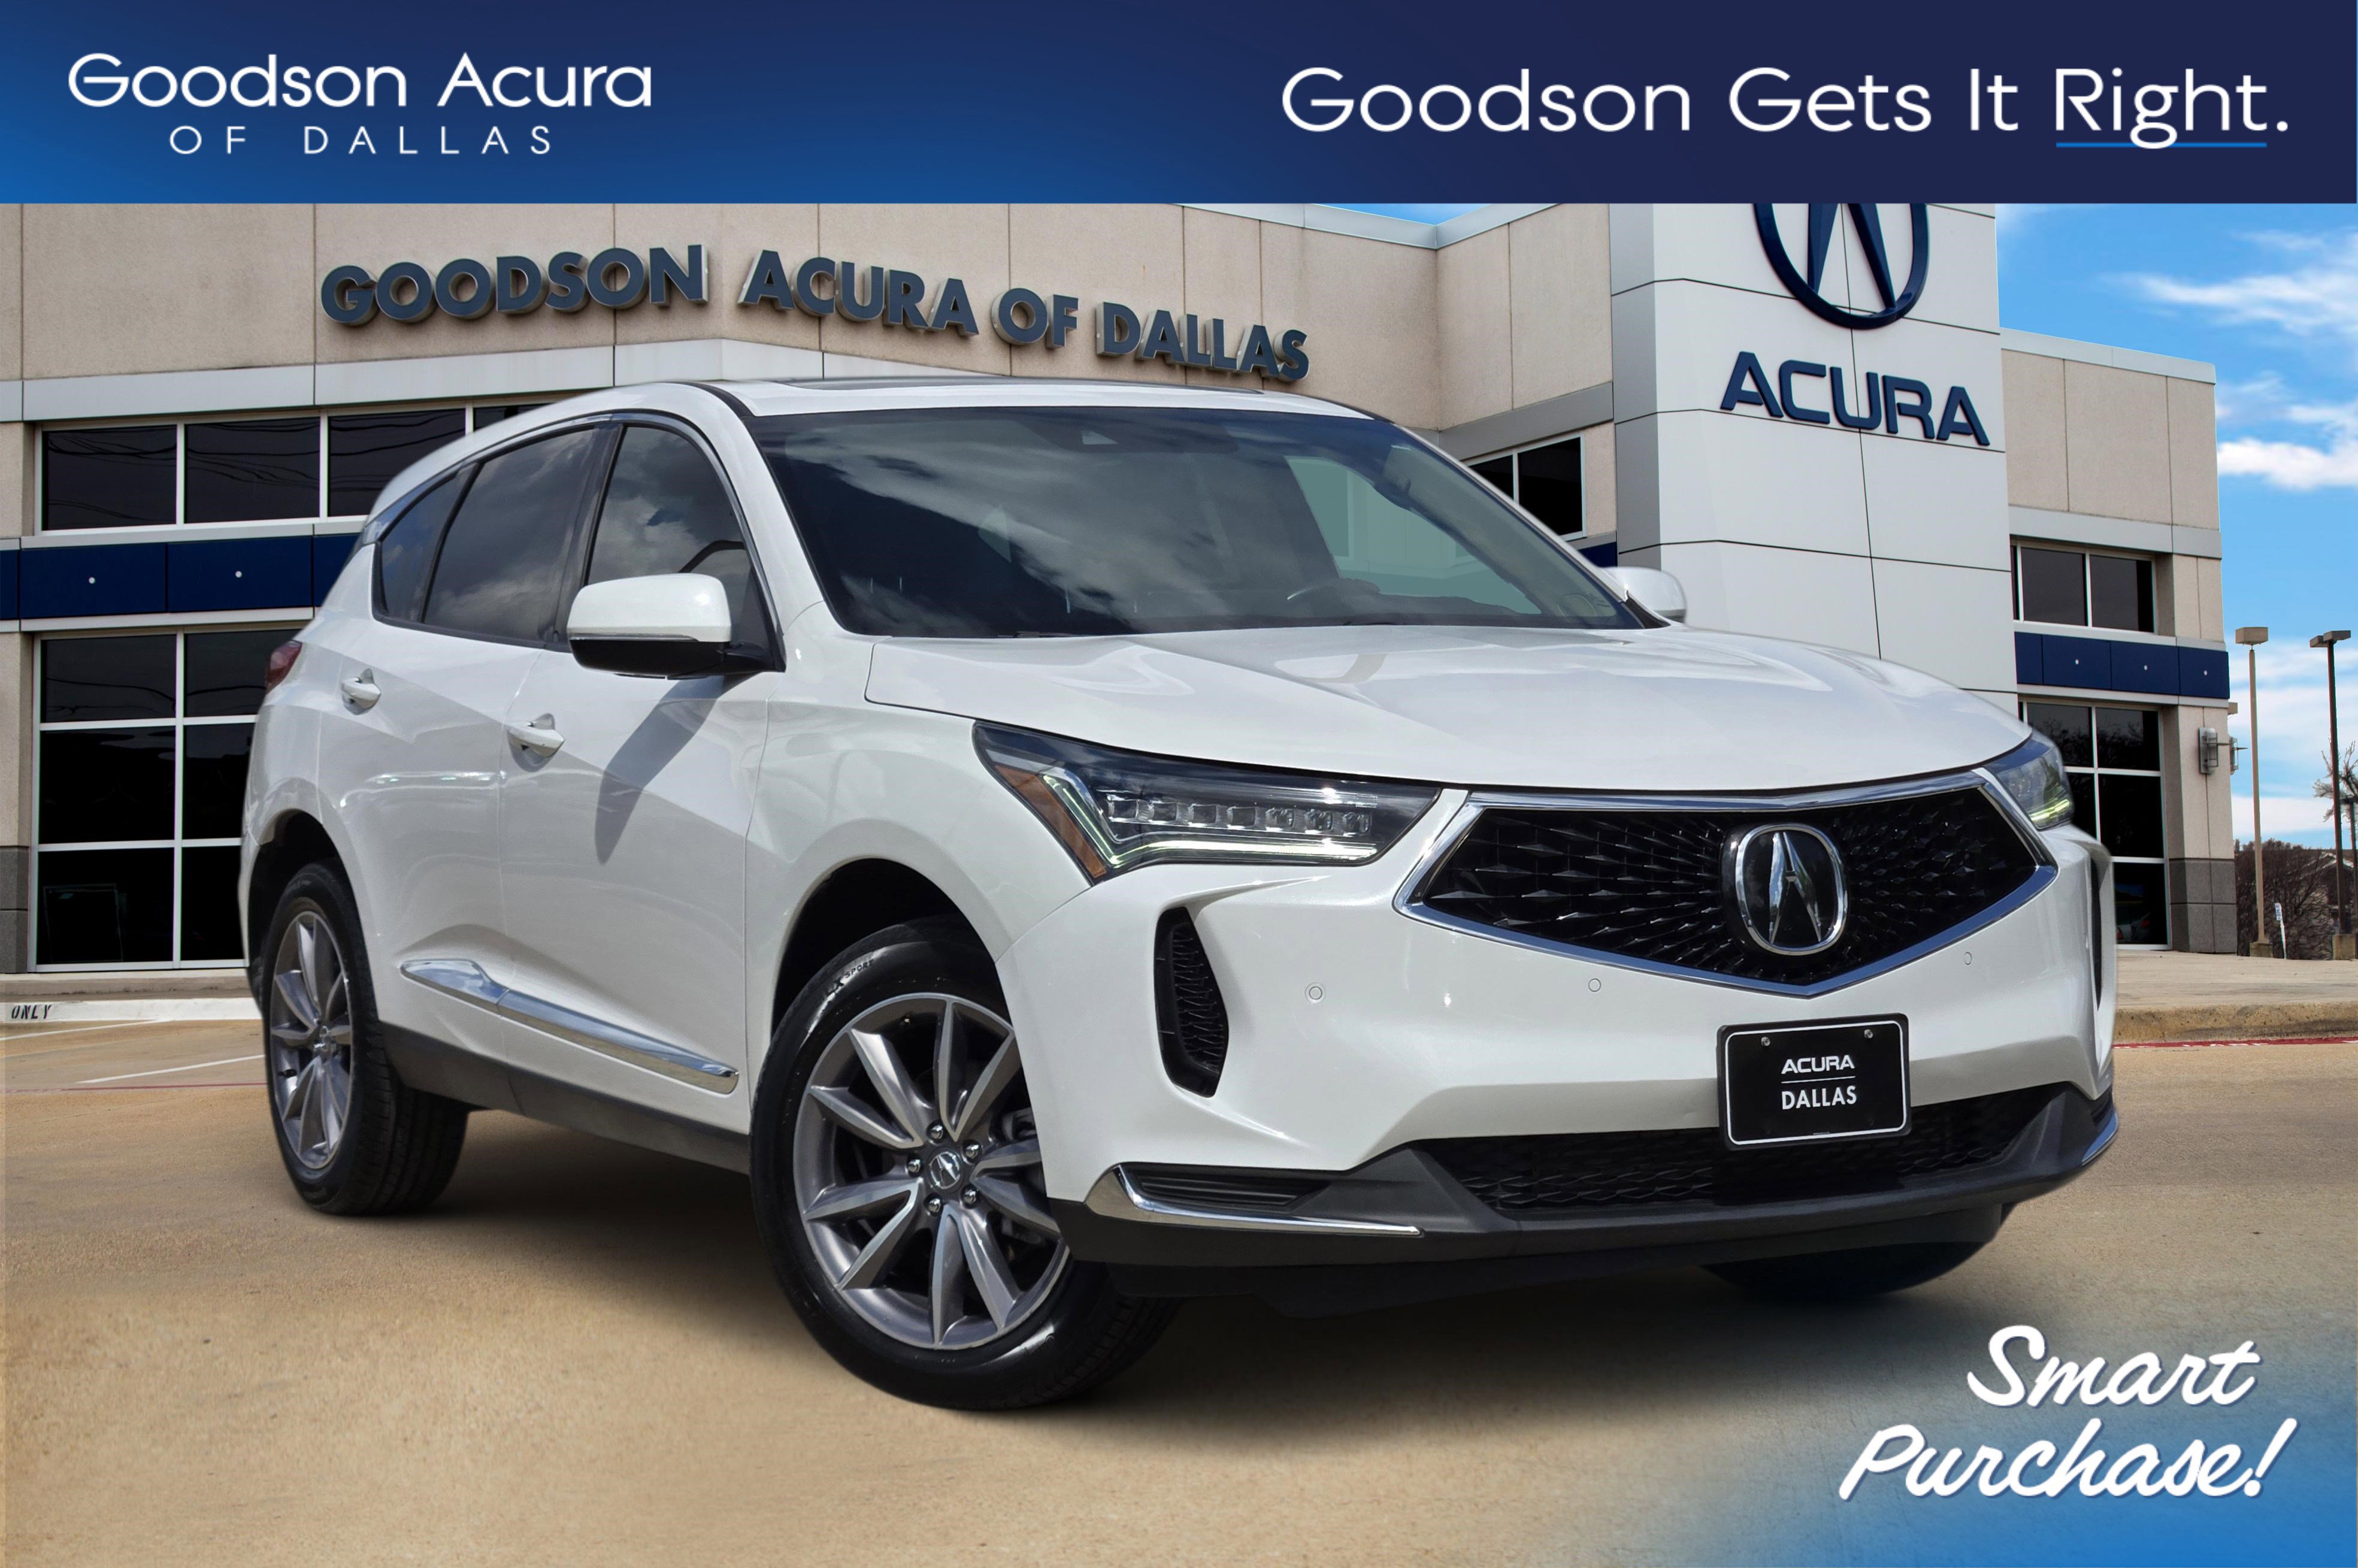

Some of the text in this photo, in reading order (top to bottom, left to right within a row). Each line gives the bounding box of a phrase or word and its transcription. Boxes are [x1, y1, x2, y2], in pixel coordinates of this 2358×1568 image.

[320, 244, 1311, 382] GOODSON ACURA OF DALLAS
[1720, 351, 1991, 446] ACURA
[844, 959, 874, 979] SPORT
[11, 1004, 52, 1019] ONLY
[1781, 1054, 1855, 1074] ACURA
[1781, 1085, 1857, 1110] DALLAS
